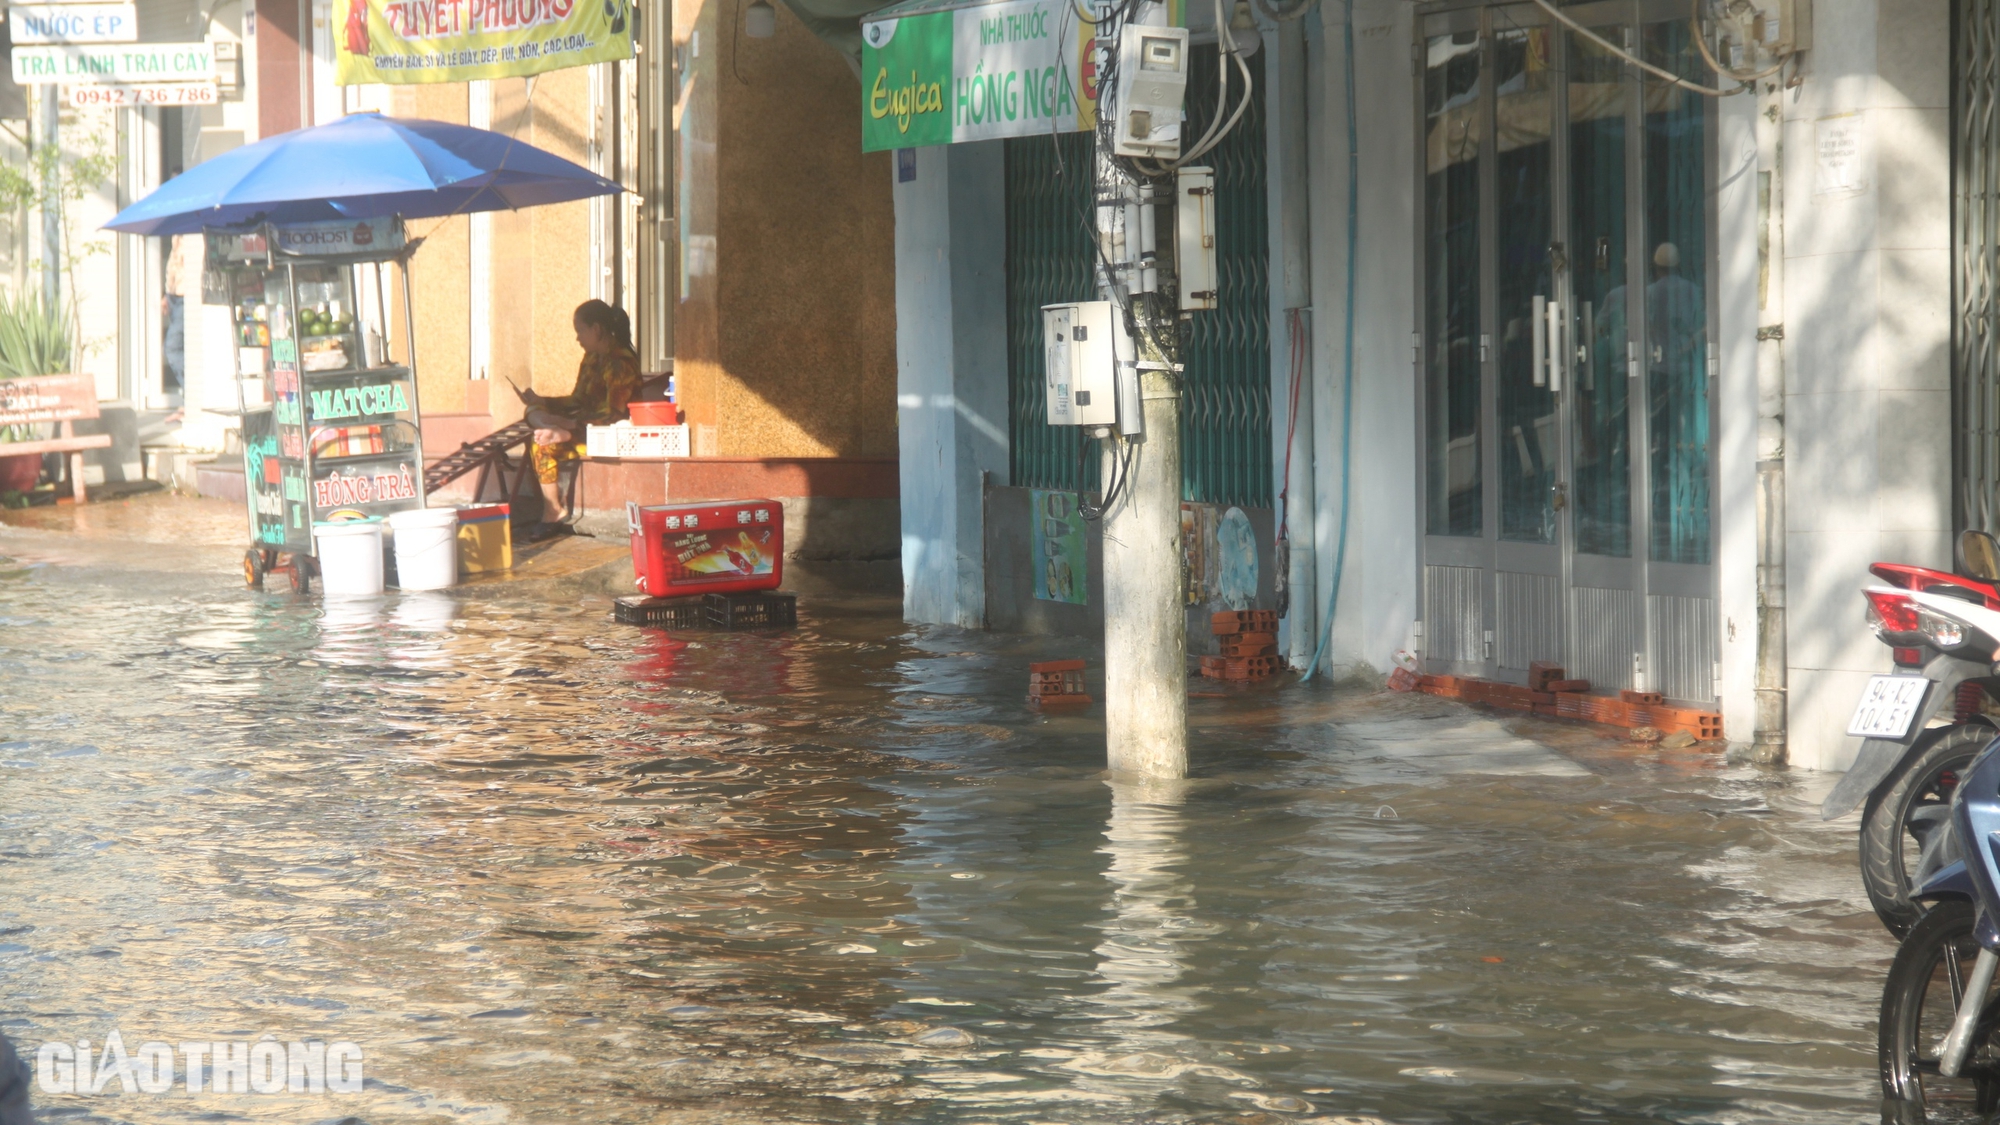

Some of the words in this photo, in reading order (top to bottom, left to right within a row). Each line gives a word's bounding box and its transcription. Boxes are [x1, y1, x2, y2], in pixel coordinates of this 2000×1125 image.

[25, 11, 84, 36] NƯỚC
[94, 10, 123, 35] ÉP
[980, 11, 1004, 46] NHÀ
[1007, 3, 1048, 42] THUỐC
[19, 49, 57, 75] TRÀ
[65, 54, 115, 78] LẠNH
[122, 47, 166, 74] TRÁI
[174, 47, 209, 73] CÂY
[76, 89, 124, 104] 0942
[132, 88, 168, 103] 736
[175, 87, 211, 102] 786
[870, 67, 943, 134] Eugica
[956, 59, 1017, 127] HỒNG
[1023, 65, 1072, 120] NGA
[311, 384, 409, 420] MATCHA
[374, 463, 416, 501] TRÀ
[1870, 680, 1916, 704] 94-K2
[1854, 707, 1910, 732] 104.51
